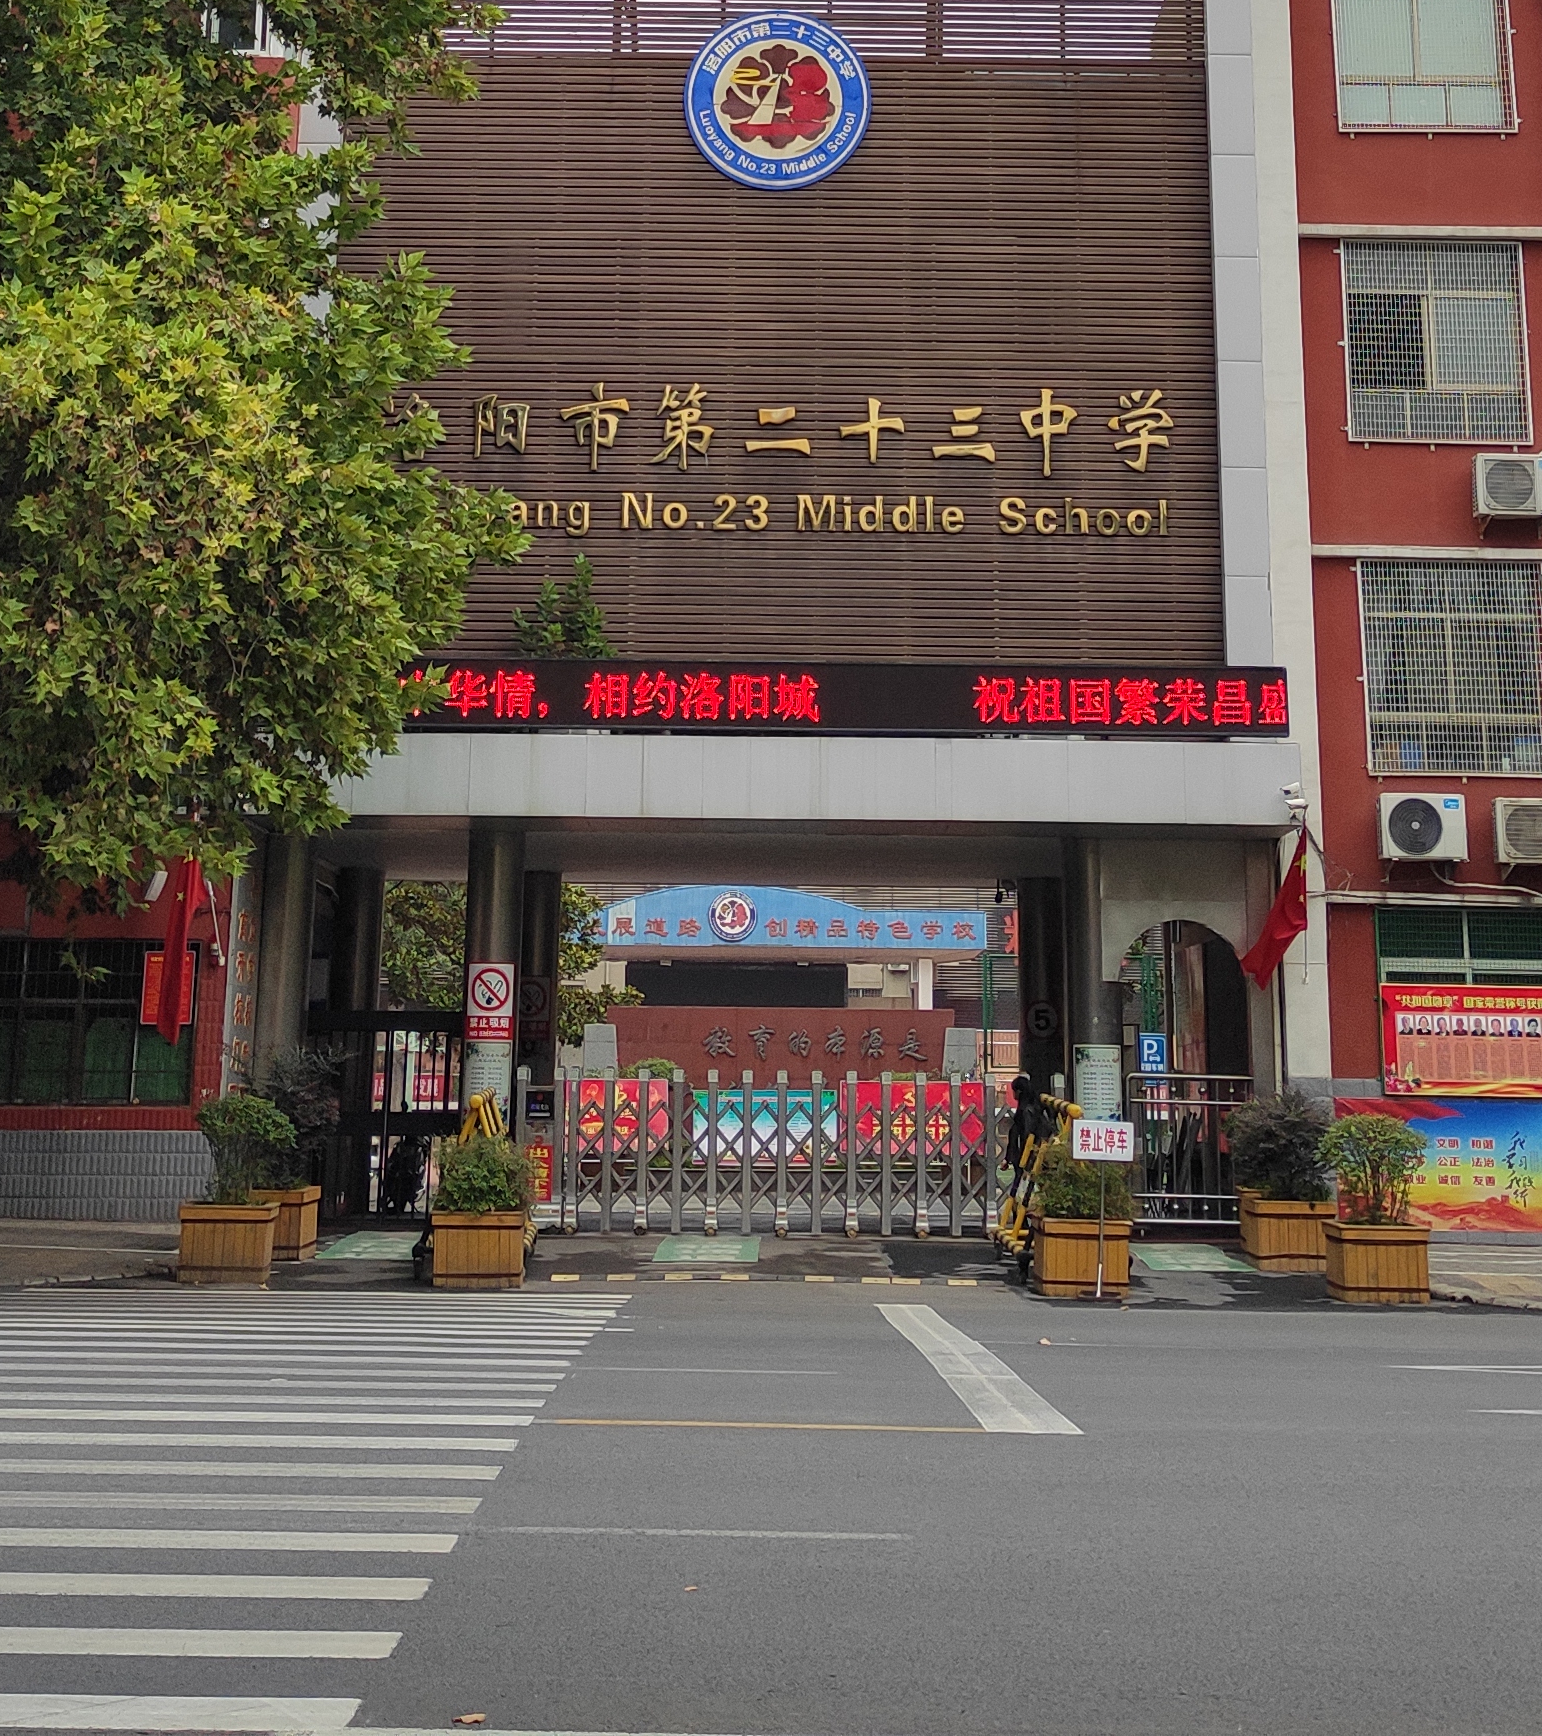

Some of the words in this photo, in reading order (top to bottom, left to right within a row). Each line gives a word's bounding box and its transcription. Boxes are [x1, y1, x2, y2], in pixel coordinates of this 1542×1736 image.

[702, 21, 856, 81] 洛阳市第二十三中学
[699, 110, 735, 161] Luoyang
[737, 154, 776, 175] No.23
[782, 151, 827, 176] Middle
[826, 111, 857, 153] School
[621, 493, 769, 532] No.23
[796, 494, 965, 534] Middle
[998, 497, 1170, 537] School
[400, 669, 821, 723] 华情，相约洛阳城
[764, 917, 977, 941] 创精品特色学校
[1034, 1009, 1051, 1031] 5
[1143, 1039, 1158, 1062] P
[1079, 1127, 1128, 1154] 禁止停车
[1437, 1156, 1461, 1168] 公正
[1471, 1156, 1495, 1168] 法治
